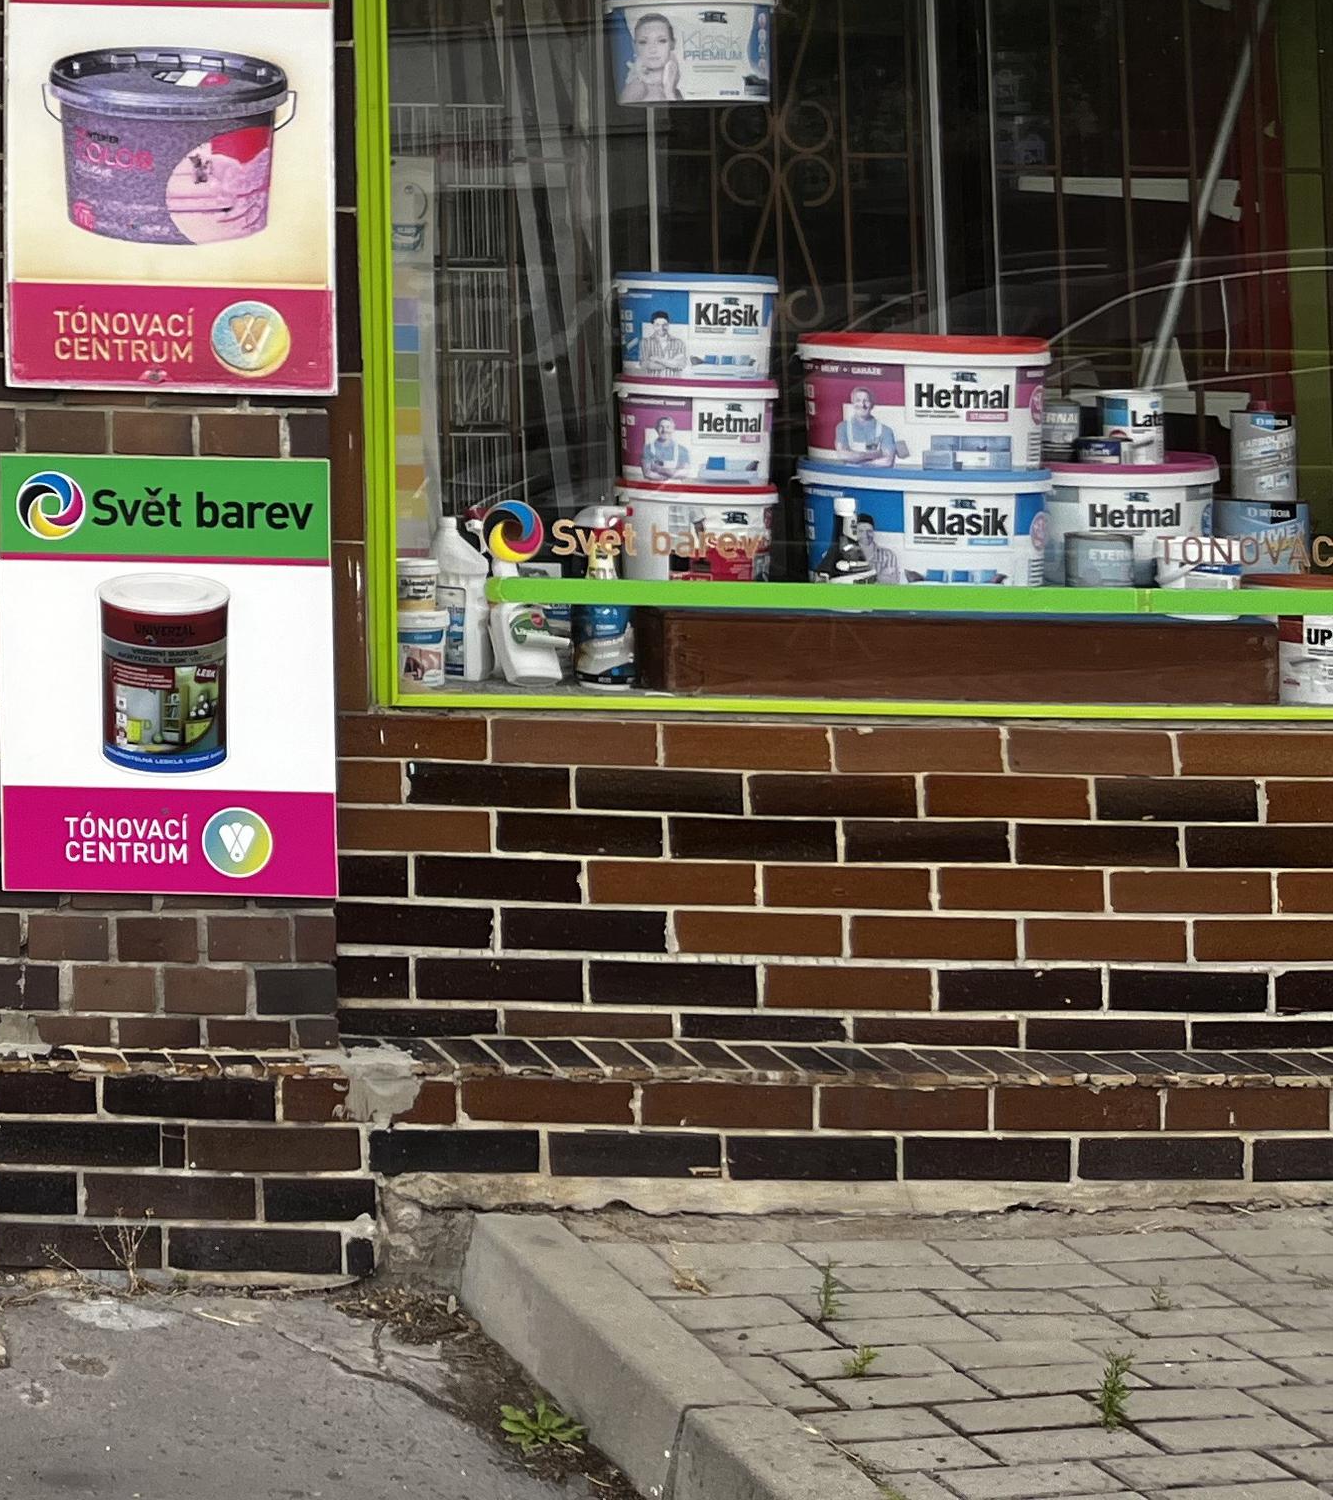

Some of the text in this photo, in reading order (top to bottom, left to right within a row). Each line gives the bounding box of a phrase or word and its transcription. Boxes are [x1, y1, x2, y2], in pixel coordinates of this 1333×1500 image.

[683, 50, 743, 61] PREMIUM
[54, 305, 194, 338] TÓNOVACÍ
[694, 302, 760, 327] Klasik
[55, 337, 194, 364] CENTRUM
[913, 383, 1011, 410] Hetmal
[697, 412, 762, 435] Hetmal
[91, 486, 314, 531] Svět barev
[912, 505, 1009, 537] Klasik
[1088, 502, 1181, 529] Hetmal
[651, 522, 764, 560] barev
[1306, 627, 1333, 646] UP
[64, 811, 188, 840] TÓNOVACÍ
[65, 840, 188, 865] CENTRUM
